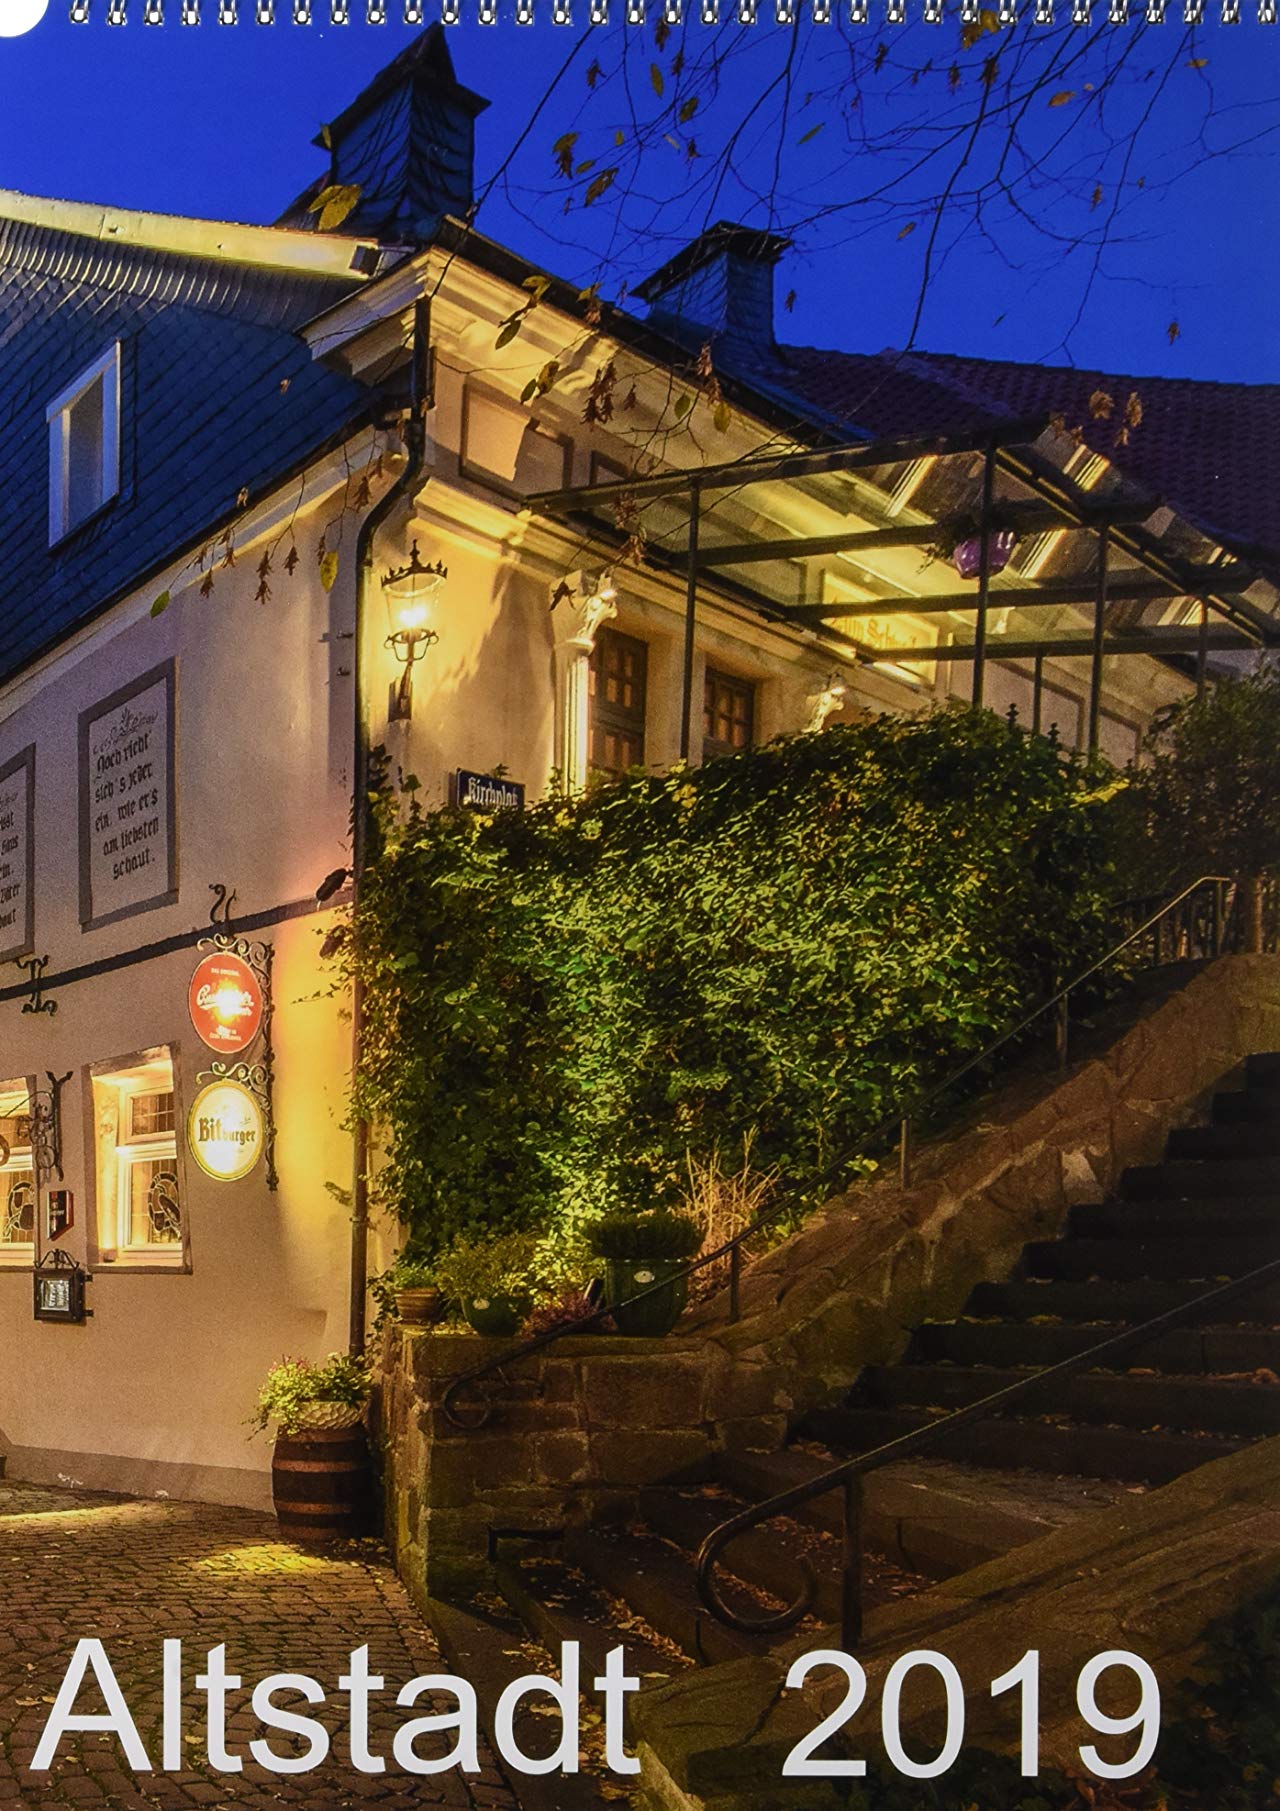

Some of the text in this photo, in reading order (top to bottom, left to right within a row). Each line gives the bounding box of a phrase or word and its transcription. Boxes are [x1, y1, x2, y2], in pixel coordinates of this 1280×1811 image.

[118, 800, 136, 821] wie
[103, 817, 159, 856] am liebsten
[198, 1117, 256, 1146] Bitburger
